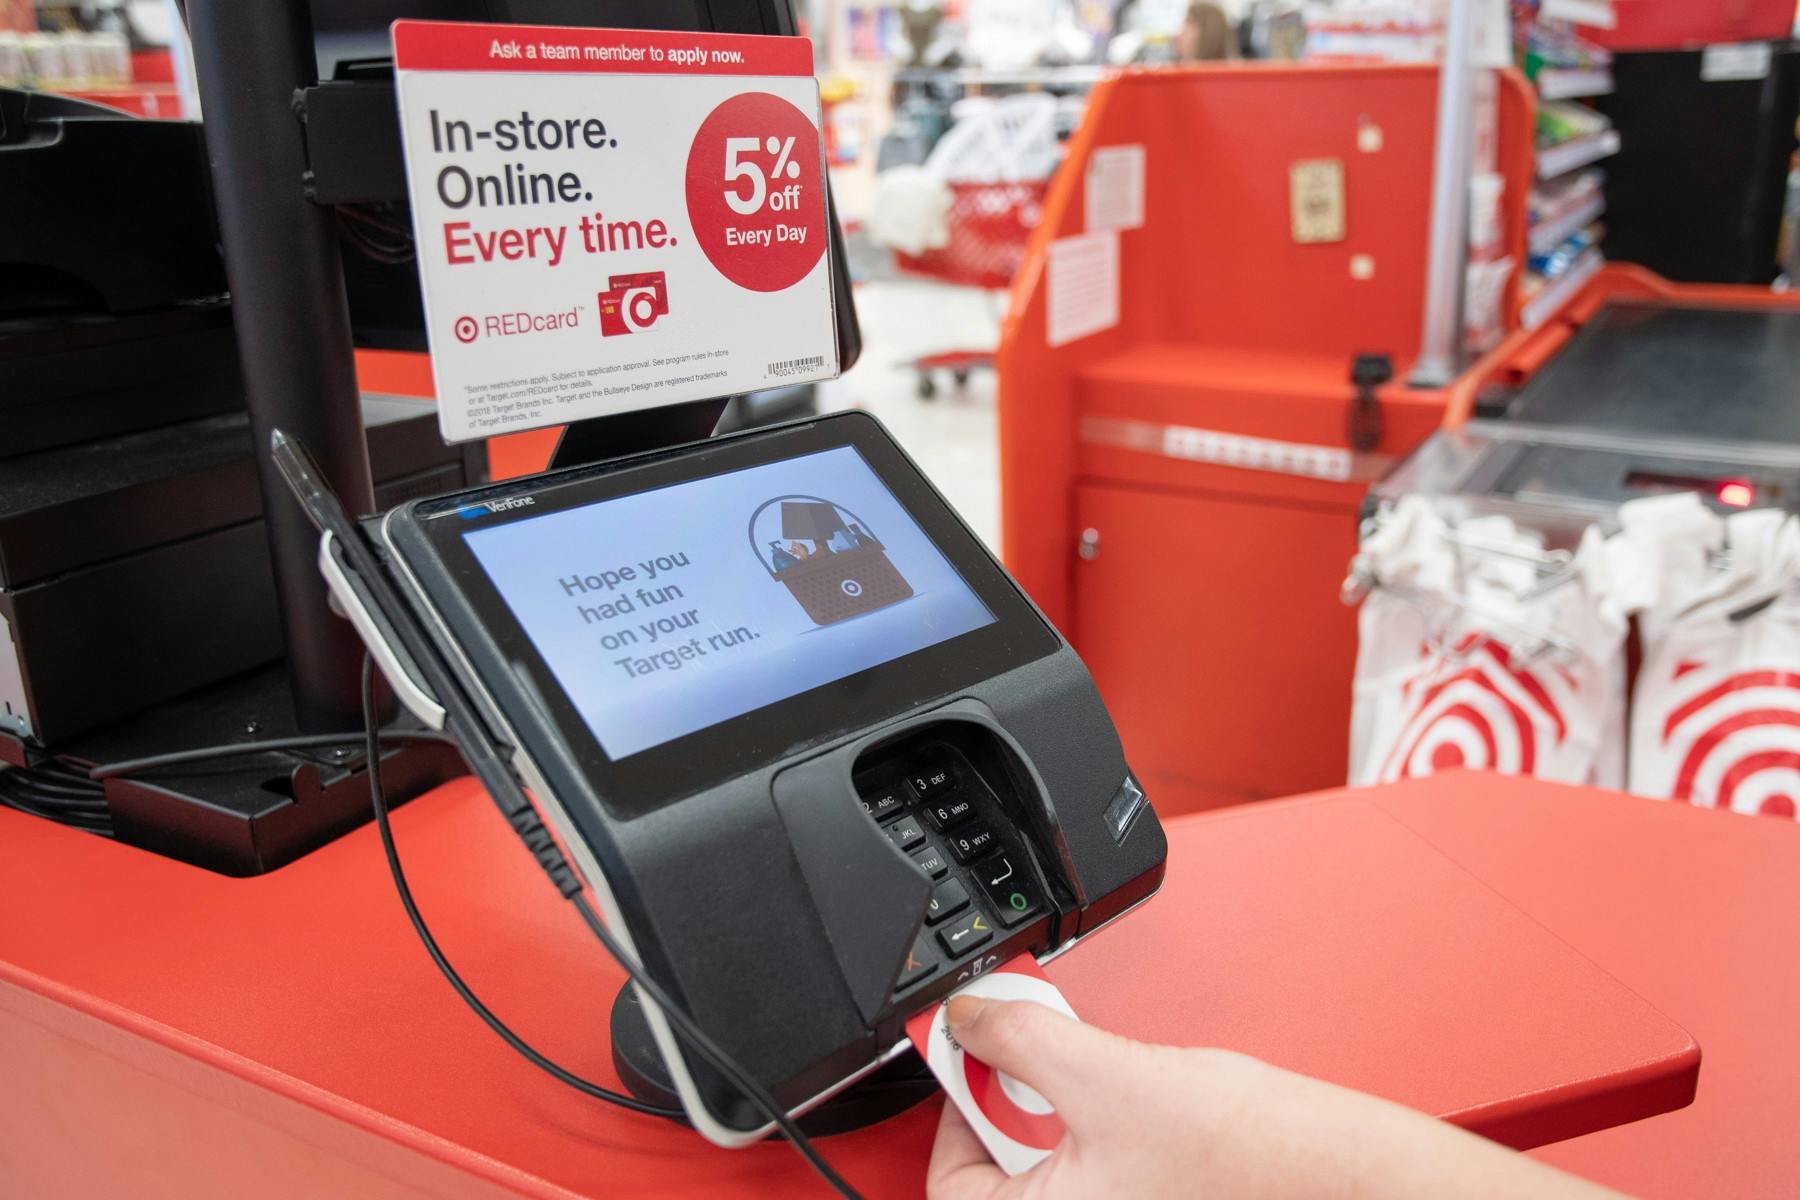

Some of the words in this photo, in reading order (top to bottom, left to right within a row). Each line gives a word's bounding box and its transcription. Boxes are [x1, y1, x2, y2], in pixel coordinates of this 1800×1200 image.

[490, 41, 522, 59] Ask
[526, 46, 537, 59] a
[540, 43, 580, 59] team
[584, 44, 645, 61] member
[650, 46, 664, 61] to
[668, 46, 707, 66] apply
[711, 50, 745, 64] now.
[430, 110, 618, 153] In-store.
[437, 163, 593, 210] Online.
[724, 136, 801, 215] 5%
[443, 221, 567, 267] Every
[579, 212, 678, 254] time.
[726, 227, 772, 248] Every
[776, 223, 808, 245] Day
[490, 378, 529, 391] restrictions
[552, 369, 577, 382] Subject
[578, 369, 586, 377] to
[587, 364, 621, 377] application
[652, 357, 665, 367] See
[666, 354, 691, 366] program
[692, 351, 707, 362] rules
[559, 382, 569, 391] for
[492, 403, 514, 414] Target
[556, 393, 578, 404] Target
[578, 390, 591, 400] and
[592, 389, 604, 398] the
[604, 385, 631, 396] Bullseye
[631, 380, 653, 392] Design
[654, 379, 664, 388] are
[665, 374, 695, 387] registered
[695, 368, 728, 382] trademarks
[468, 420, 477, 429] of
[478, 416, 501, 428] Target
[558, 566, 637, 597] Hope
[638, 551, 691, 580] you
[577, 593, 636, 625] had
[636, 584, 685, 608] fun
[601, 628, 639, 651] on
[639, 608, 700, 643] your
[613, 638, 708, 679] Target
[707, 625, 761, 652] run.
[916, 778, 927, 790] 3
[930, 772, 946, 785] DEF
[877, 795, 895, 809] ABC
[937, 808, 948, 820] 6
[951, 802, 969, 815] MNO
[901, 828, 916, 840] JKL
[959, 838, 970, 851] 9
[972, 832, 991, 847] WXY
[921, 858, 939, 872] TUV
